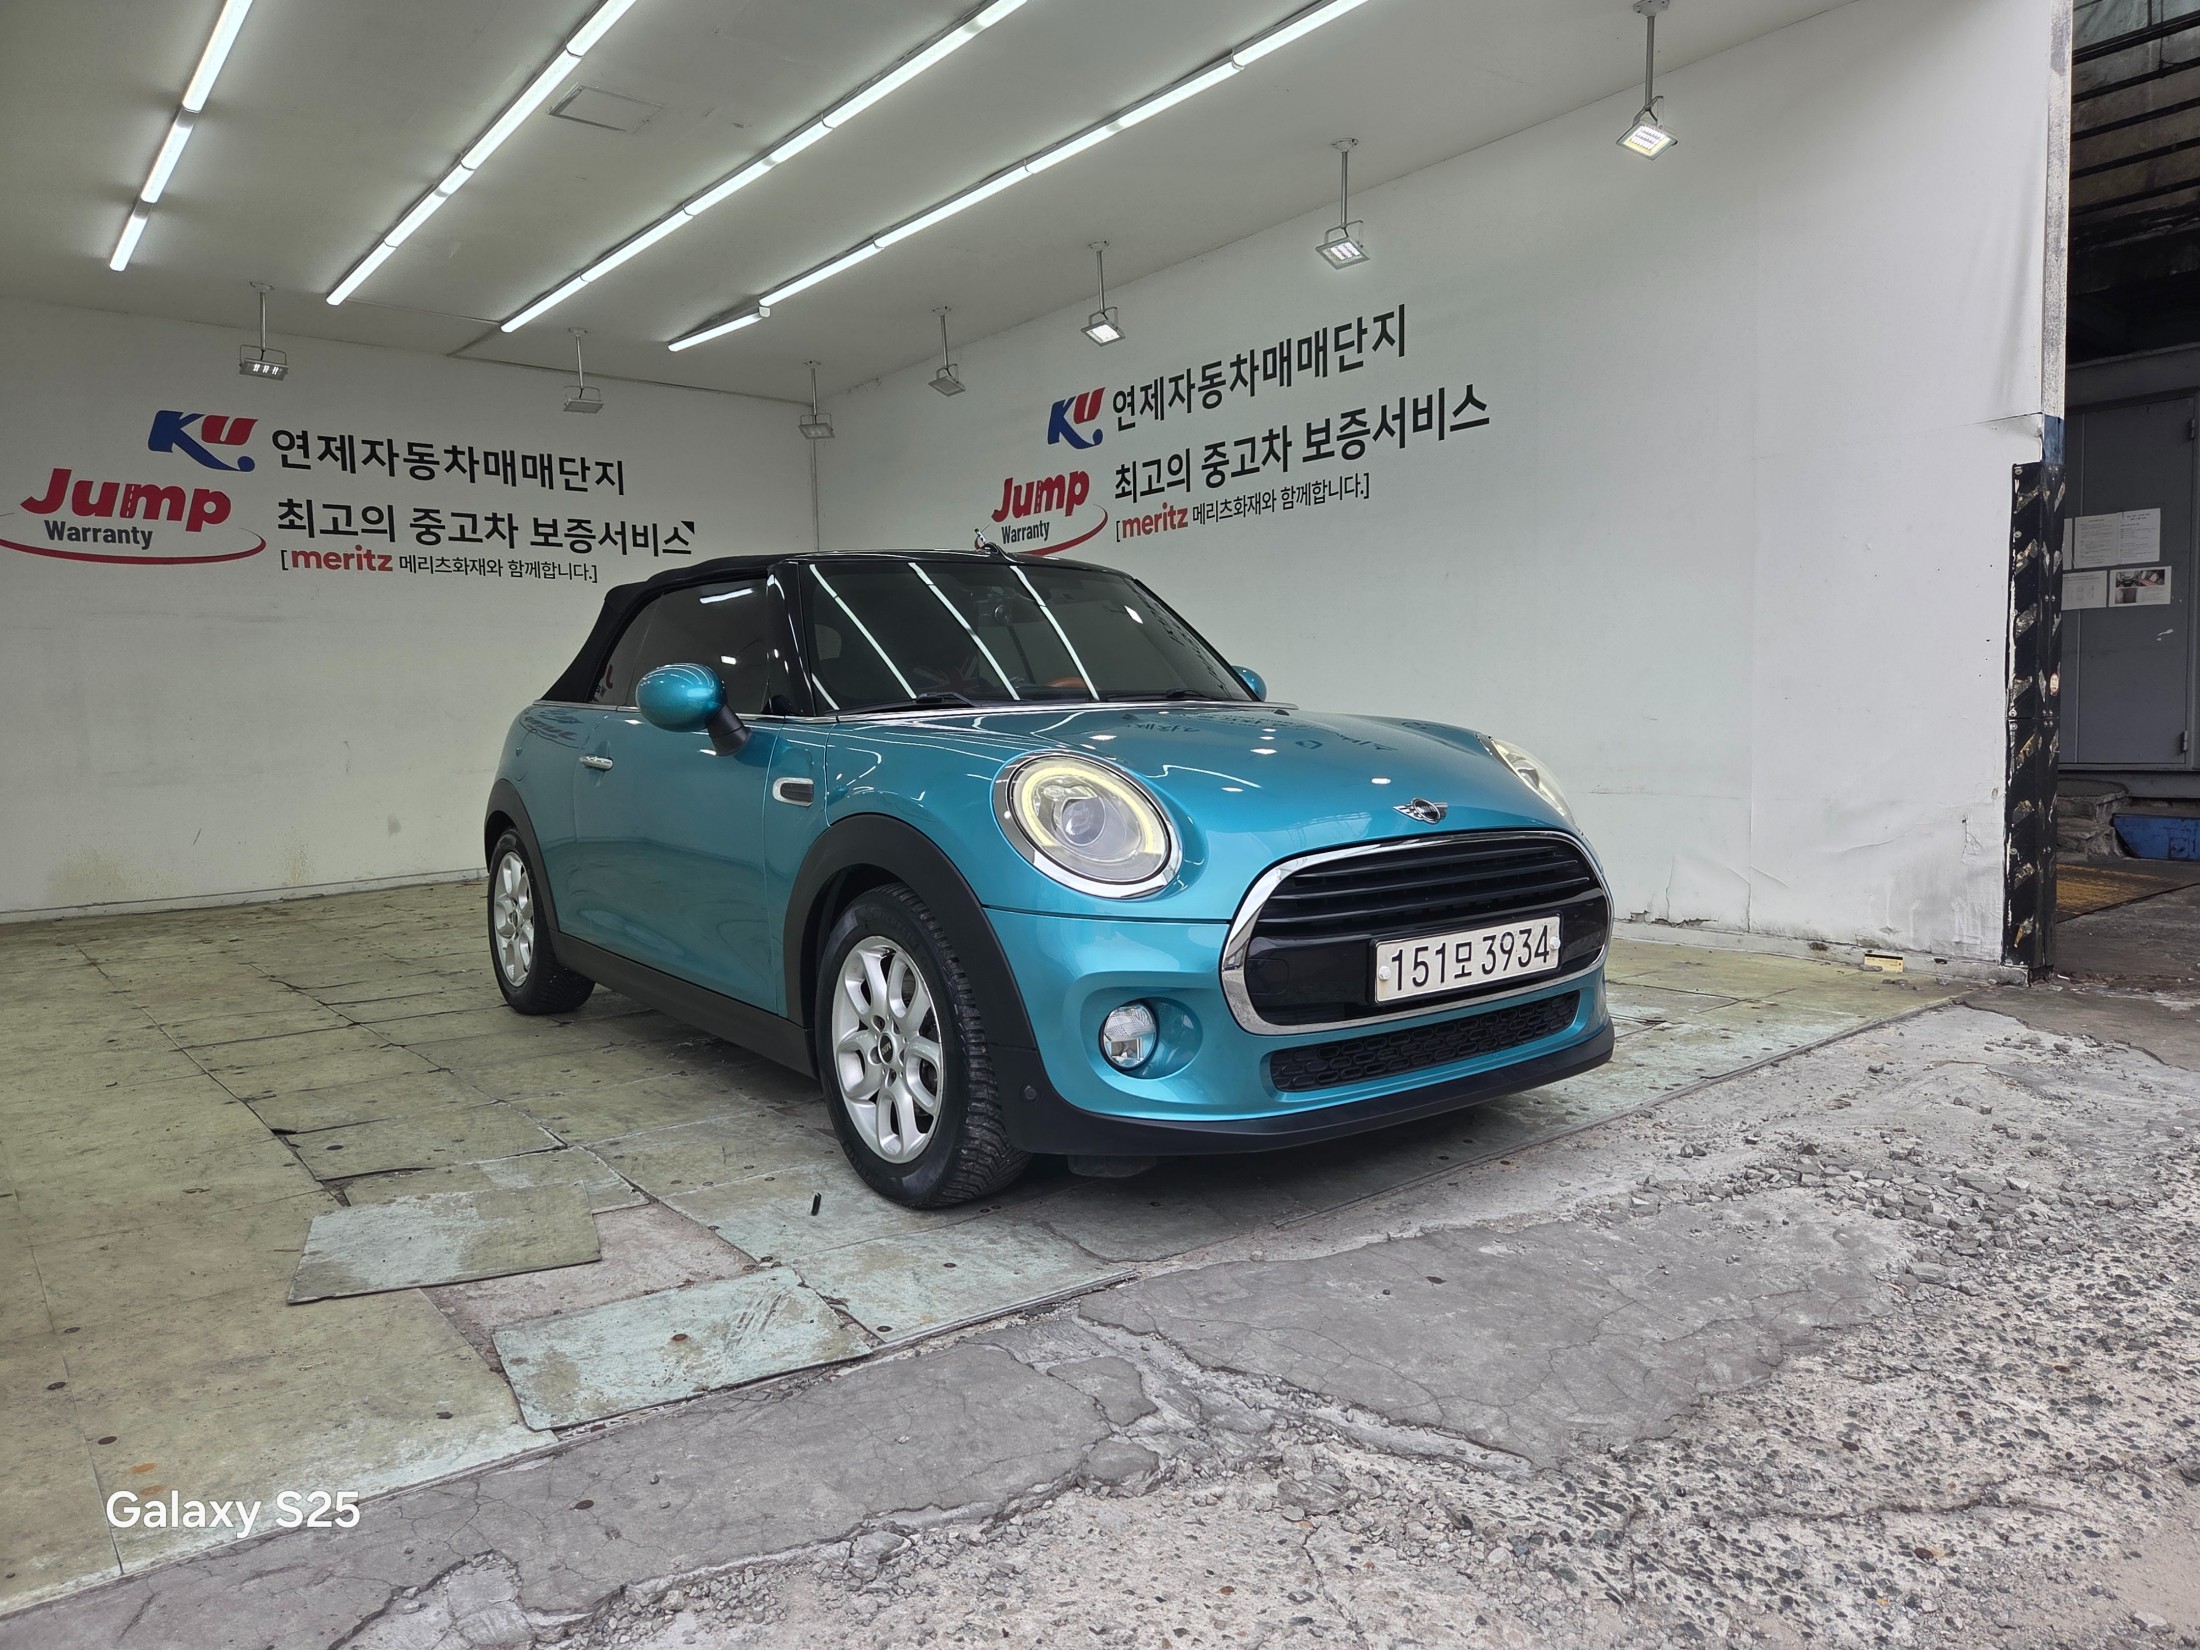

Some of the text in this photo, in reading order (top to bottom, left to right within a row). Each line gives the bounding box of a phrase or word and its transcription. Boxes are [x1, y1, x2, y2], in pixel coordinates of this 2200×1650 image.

[1112, 303, 1406, 431] 연제자동차매매단지
[271, 428, 625, 496] 연제자동차매매단지
[1114, 384, 1491, 504] 최고의 중고차 보증서비스
[20, 468, 232, 533] Jump
[991, 470, 1090, 523] Jump
[1192, 489, 1277, 526] 메리츠화재와
[1280, 472, 1370, 510] 함께합니다.]
[44, 519, 153, 551] Warranty
[277, 498, 692, 557] 최고의 중고차 보증서비스
[1001, 520, 1050, 545] Warranty
[399, 554, 504, 578] 메리츠화재와
[507, 559, 598, 584] 함께합니다.]
